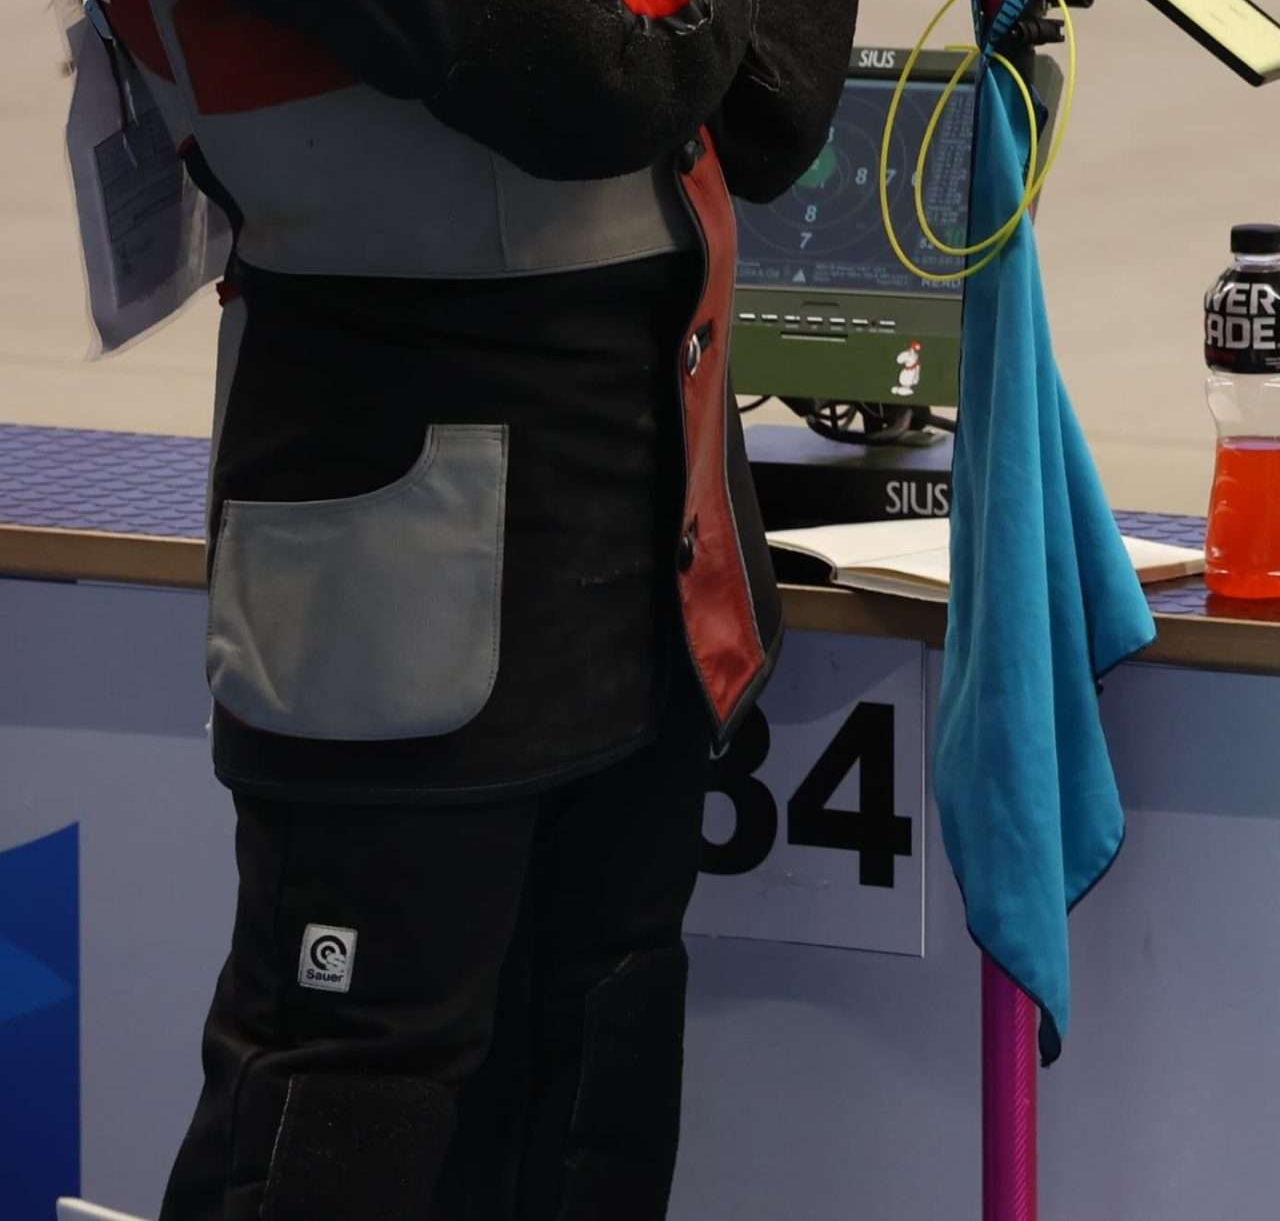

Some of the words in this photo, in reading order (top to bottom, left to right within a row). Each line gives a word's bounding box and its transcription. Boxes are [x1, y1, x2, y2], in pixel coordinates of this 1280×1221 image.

[858, 49, 895, 68] SIUS
[885, 481, 950, 516] SIUS
[306, 968, 345, 983] Sauer
